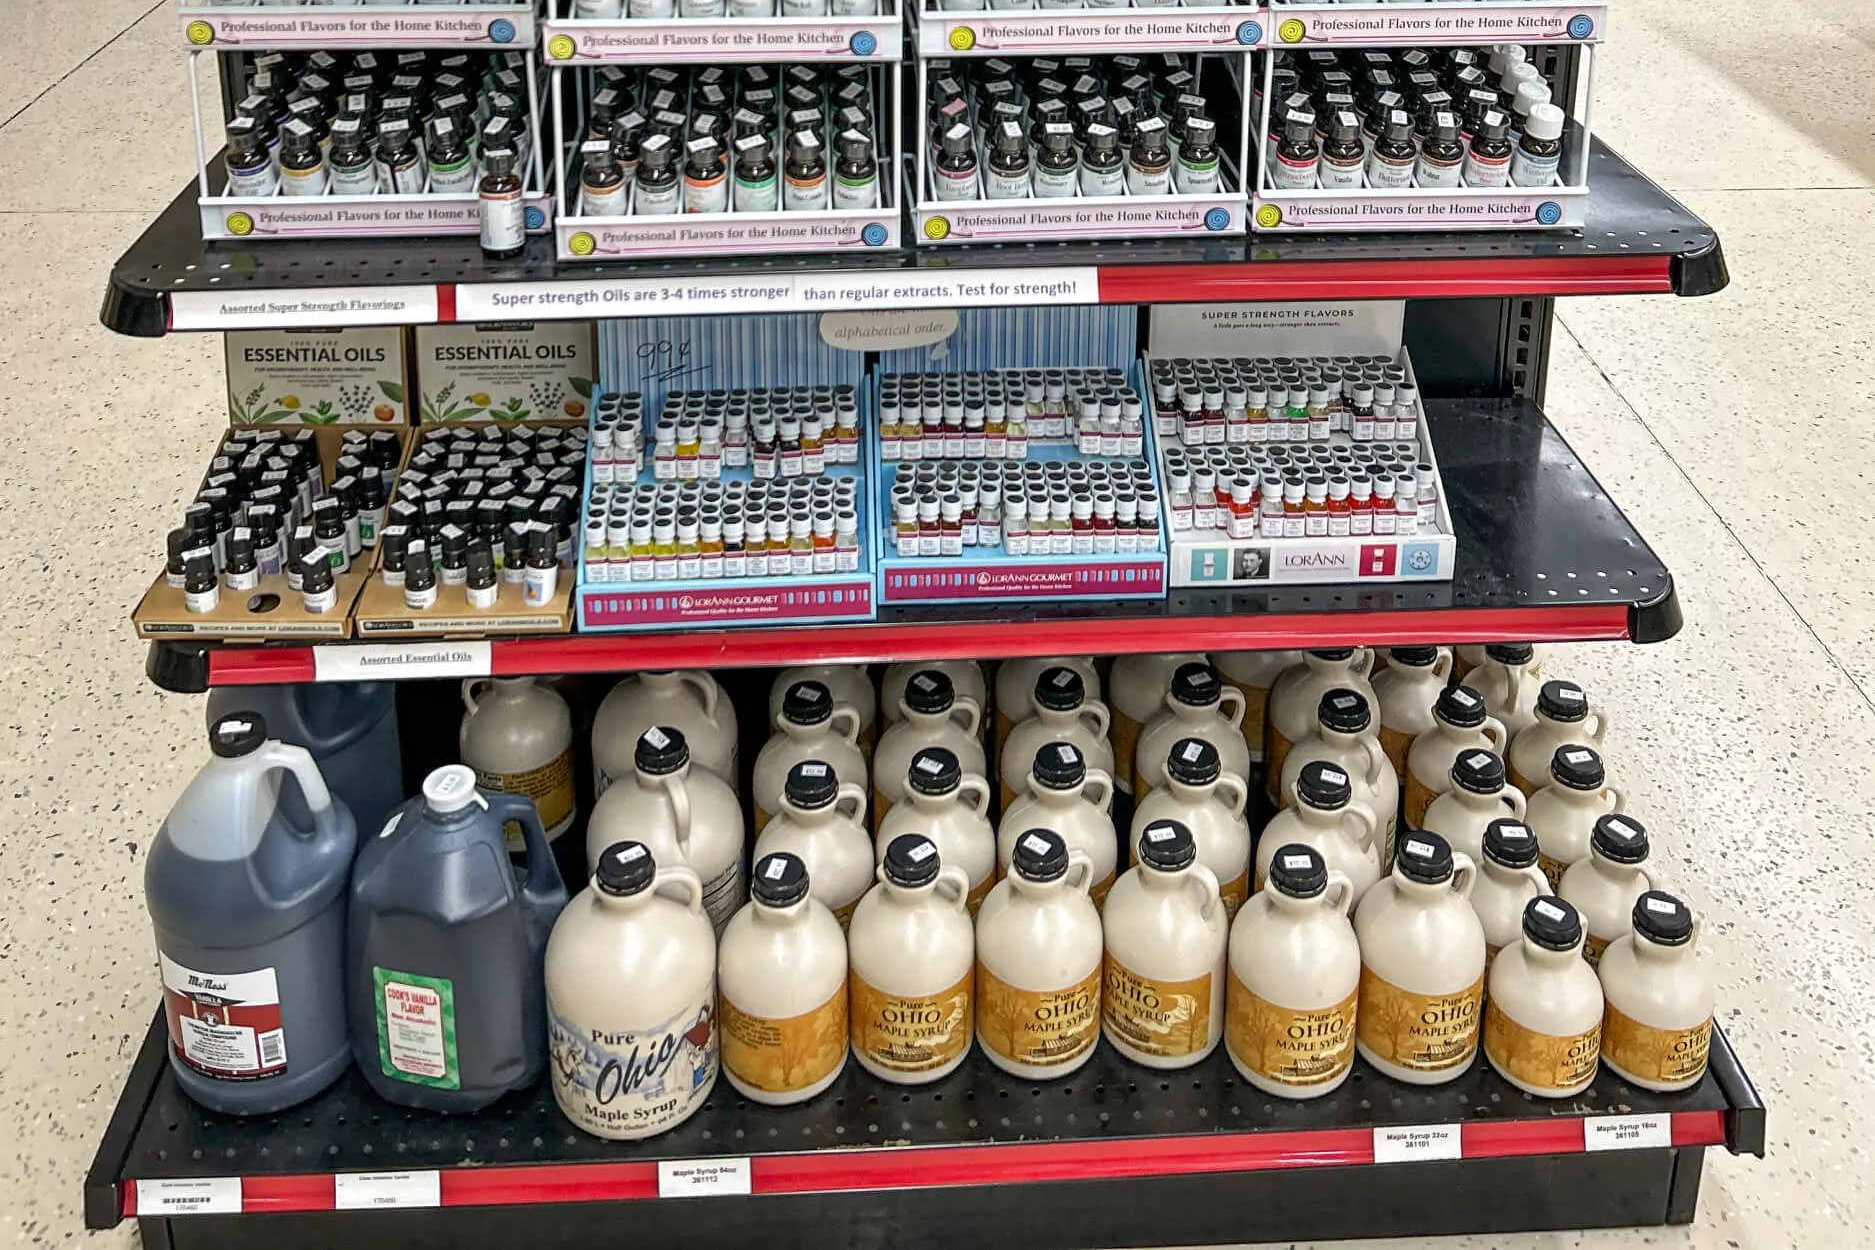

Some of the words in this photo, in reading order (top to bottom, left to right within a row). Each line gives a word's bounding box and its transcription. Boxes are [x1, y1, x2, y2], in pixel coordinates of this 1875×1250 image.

[220, 19, 298, 34] Professional
[300, 19, 346, 32] Flavors
[349, 19, 367, 32] for
[371, 19, 391, 32] the
[394, 19, 432, 31] Home
[435, 18, 483, 31] Kitchen
[982, 25, 1054, 39] Professional
[1057, 23, 1100, 37] Flavors
[1103, 23, 1121, 36] for
[1124, 23, 1143, 35] the
[1147, 22, 1182, 35] Home
[1185, 20, 1231, 34] Kitchen
[1312, 17, 1384, 31] Professional
[1388, 17, 1432, 30] Flavors
[1434, 16, 1452, 29] for
[1455, 16, 1475, 29] the
[1478, 16, 1514, 28] Home
[1517, 15, 1563, 28] Kitchen
[583, 33, 660, 48] Professional
[663, 32, 709, 46] Flavors
[711, 32, 730, 45] for
[733, 32, 753, 45] the
[757, 31, 795, 44] Home
[798, 30, 845, 44] Kitchen
[259, 210, 334, 224] Professional
[336, 209, 381, 222] Flavors
[384, 209, 402, 222] for
[405, 208, 424, 221] the
[427, 208, 464, 220] Home
[956, 212, 1027, 227] Professional
[1030, 211, 1073, 224] Flavors
[1075, 211, 1092, 223] for
[1095, 211, 1114, 223] the
[1118, 210, 1152, 222] Home
[1155, 208, 1200, 221] Kitchen
[1288, 204, 1359, 218] Professional
[1362, 204, 1404, 216] Flavors
[1406, 203, 1424, 216] for
[1427, 203, 1446, 216] the
[1449, 203, 1485, 215] Home
[1487, 201, 1531, 215] Kitchen
[602, 229, 677, 244] Professional
[680, 228, 725, 241] Flavors
[727, 227, 745, 240] for
[748, 227, 768, 240] the
[771, 226, 807, 238] Home
[811, 224, 856, 237] Kitchen
[491, 292, 535, 308] Super
[538, 290, 599, 307] strength
[603, 288, 630, 303] Oils
[633, 290, 657, 302] are
[660, 286, 683, 301] 3-4
[686, 285, 727, 301] times
[730, 286, 790, 303] stronger
[803, 287, 836, 301] than
[840, 285, 888, 301] regular
[956, 283, 986, 297] Test
[989, 282, 1010, 296] for
[1013, 280, 1077, 297] strength!
[219, 302, 266, 315] Assorted
[268, 302, 298, 315] Super
[300, 300, 348, 314] Strength
[1201, 311, 1238, 320] SUPER
[1241, 310, 1300, 319] STRENGTH
[1303, 309, 1355, 318] FLAVORS
[834, 323, 912, 340] alphabetical
[914, 321, 947, 335] order.
[244, 348, 341, 363] ESSENTIAL
[344, 347, 386, 362] OILS
[435, 345, 532, 361] ESSENTIAL
[535, 344, 577, 360] OILS
[359, 654, 403, 666] Assorted
[406, 653, 450, 664] Essential
[452, 652, 473, 663] Oils
[411, 991, 438, 1007] VANILLA
[1054, 991, 1078, 1003] Pure
[1108, 973, 1161, 1010] OHIO
[400, 1002, 425, 1016] FLAVOR
[899, 999, 925, 1011] Pure
[1034, 994, 1089, 1021] OHIO
[1421, 1000, 1475, 1026] OHIO
[881, 1009, 942, 1024] OHIO
[1306, 1012, 1331, 1024] Pure
[873, 1019, 909, 1039] MAPLE
[1023, 1020, 1063, 1033] MAPLE
[1287, 1017, 1345, 1040] OHIO
[1408, 1023, 1450, 1037] MAPLE
[591, 1028, 636, 1046] Pure
[1275, 1037, 1315, 1052] MAPLE
[595, 1032, 684, 1105] Ohio
[584, 1101, 630, 1122] Maple
[633, 1097, 678, 1120] Syrup
